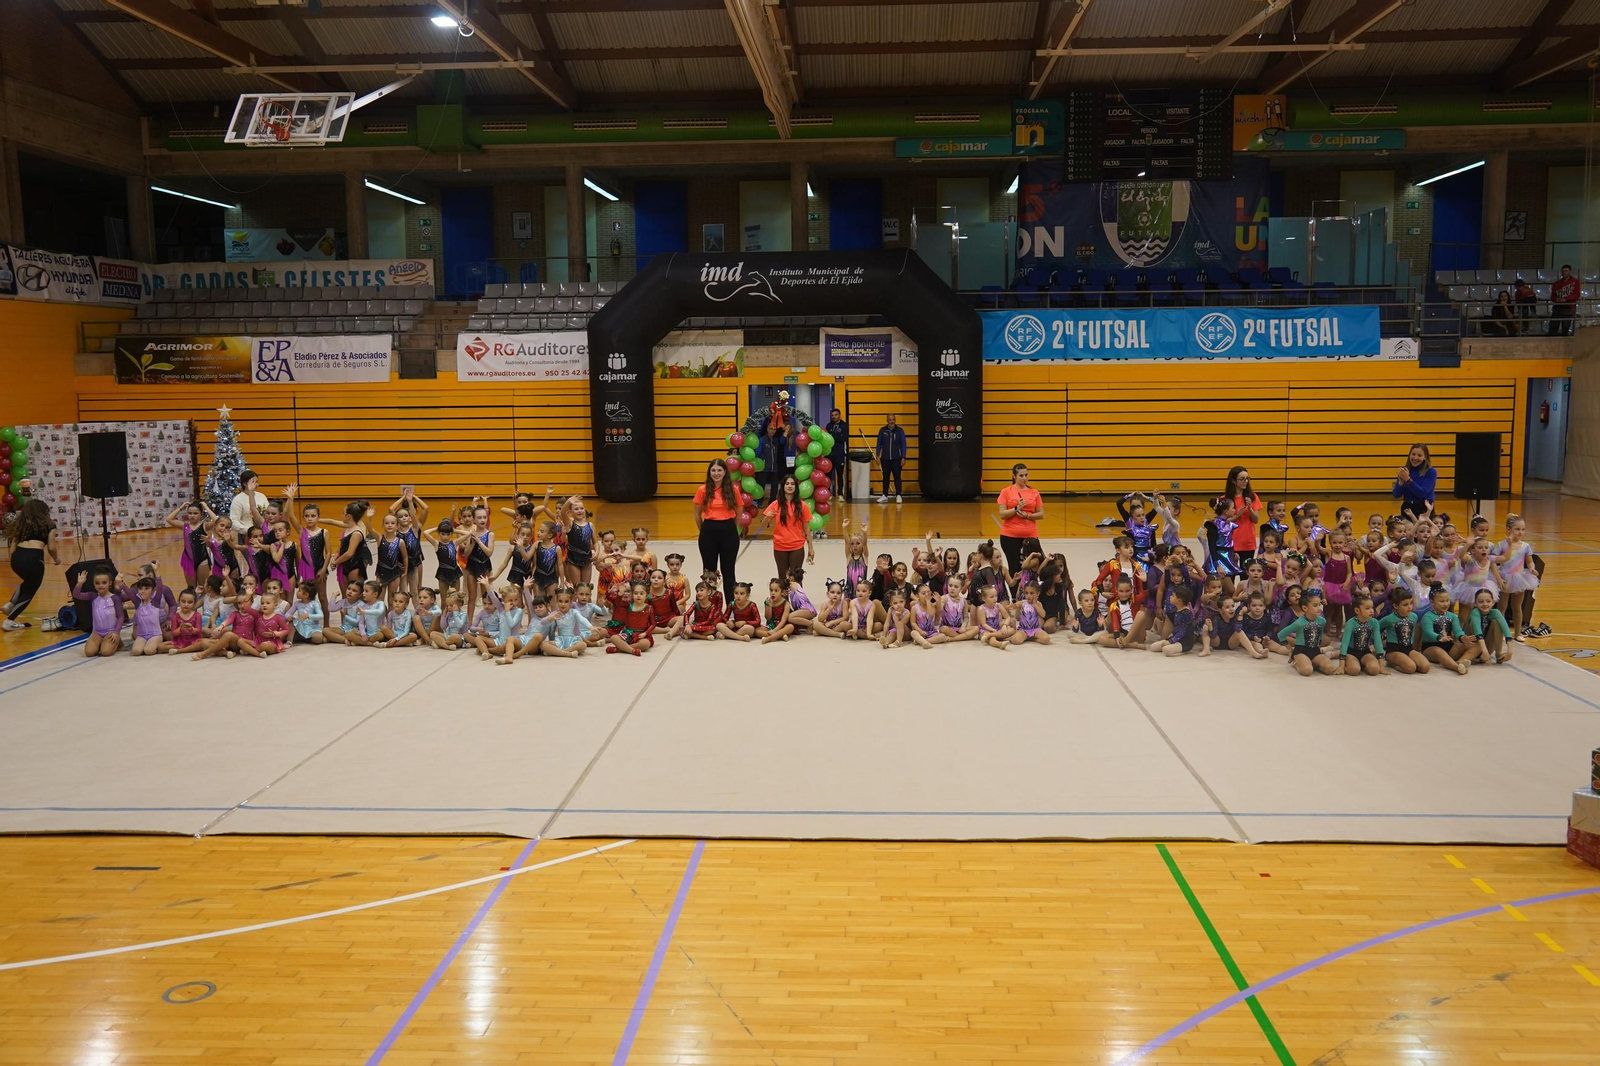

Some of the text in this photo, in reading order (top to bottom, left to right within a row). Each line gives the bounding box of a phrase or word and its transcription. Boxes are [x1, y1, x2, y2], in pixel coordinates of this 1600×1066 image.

[935, 140, 988, 154] cajamar
[1324, 133, 1380, 148] cajamar
[1236, 196, 1269, 222] LA
[12, 248, 52, 264] TALLERES
[101, 265, 137, 279] ELECTRO
[700, 262, 744, 282] imd
[808, 267, 849, 277] Municipal
[142, 272, 249, 295] BRGADAS
[781, 277, 816, 287] Deportes
[841, 276, 863, 286] Ejido
[1078, 320, 1150, 349] FUTSAL
[1270, 317, 1343, 347] FUTSAL
[144, 343, 213, 351] AGRIMOR
[257, 341, 291, 362] EP
[852, 341, 885, 350] poniente
[319, 352, 339, 360] Pérez
[344, 360, 372, 369] Seguros
[599, 371, 637, 383] cajamar
[930, 368, 970, 379] cajamar
[605, 401, 620, 410] imd
[936, 398, 951, 407] imd
